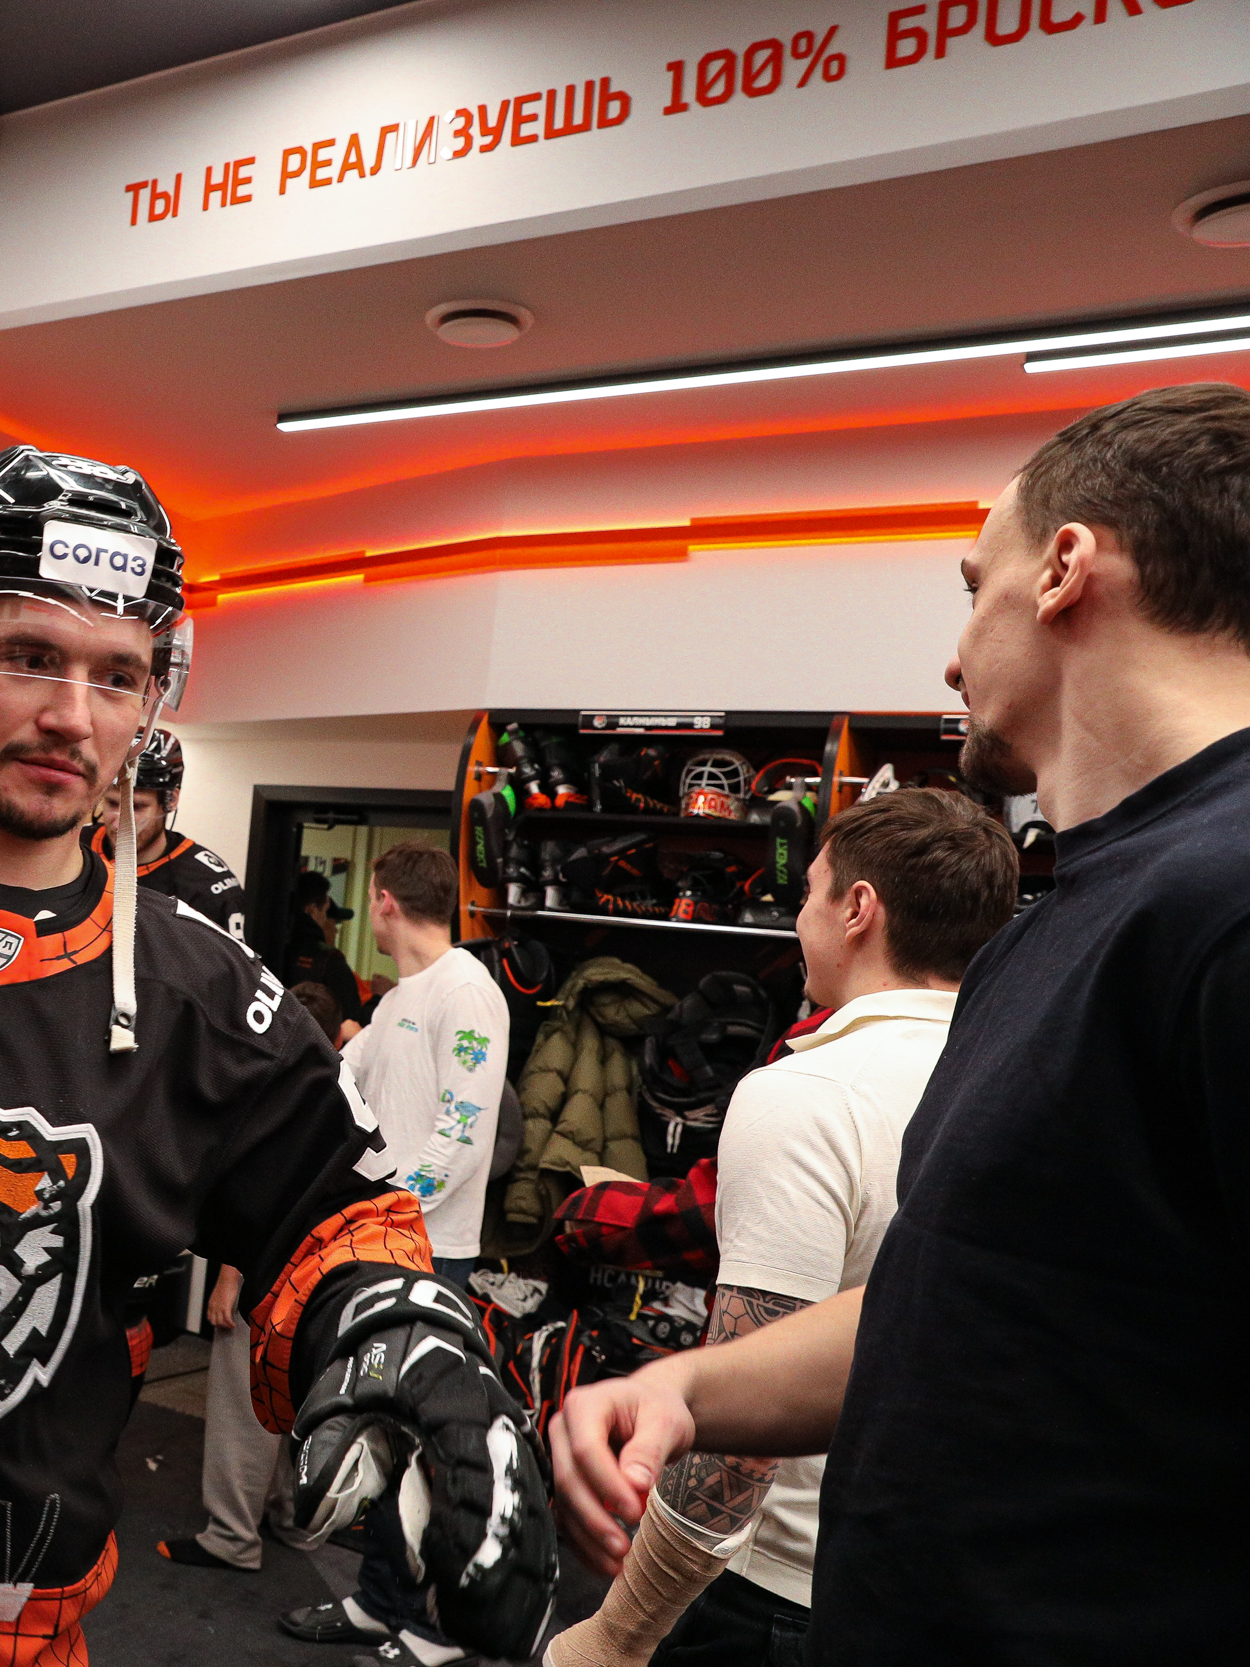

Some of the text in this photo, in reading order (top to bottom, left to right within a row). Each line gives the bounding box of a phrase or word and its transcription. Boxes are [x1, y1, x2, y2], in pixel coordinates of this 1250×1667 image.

[125, 0, 1195, 226] ТЫ НЕ РЕАЛИЗУЕШЬ 100% БРОС
[49, 538, 147, 578] согаз
[338, 1277, 486, 1346] CC
